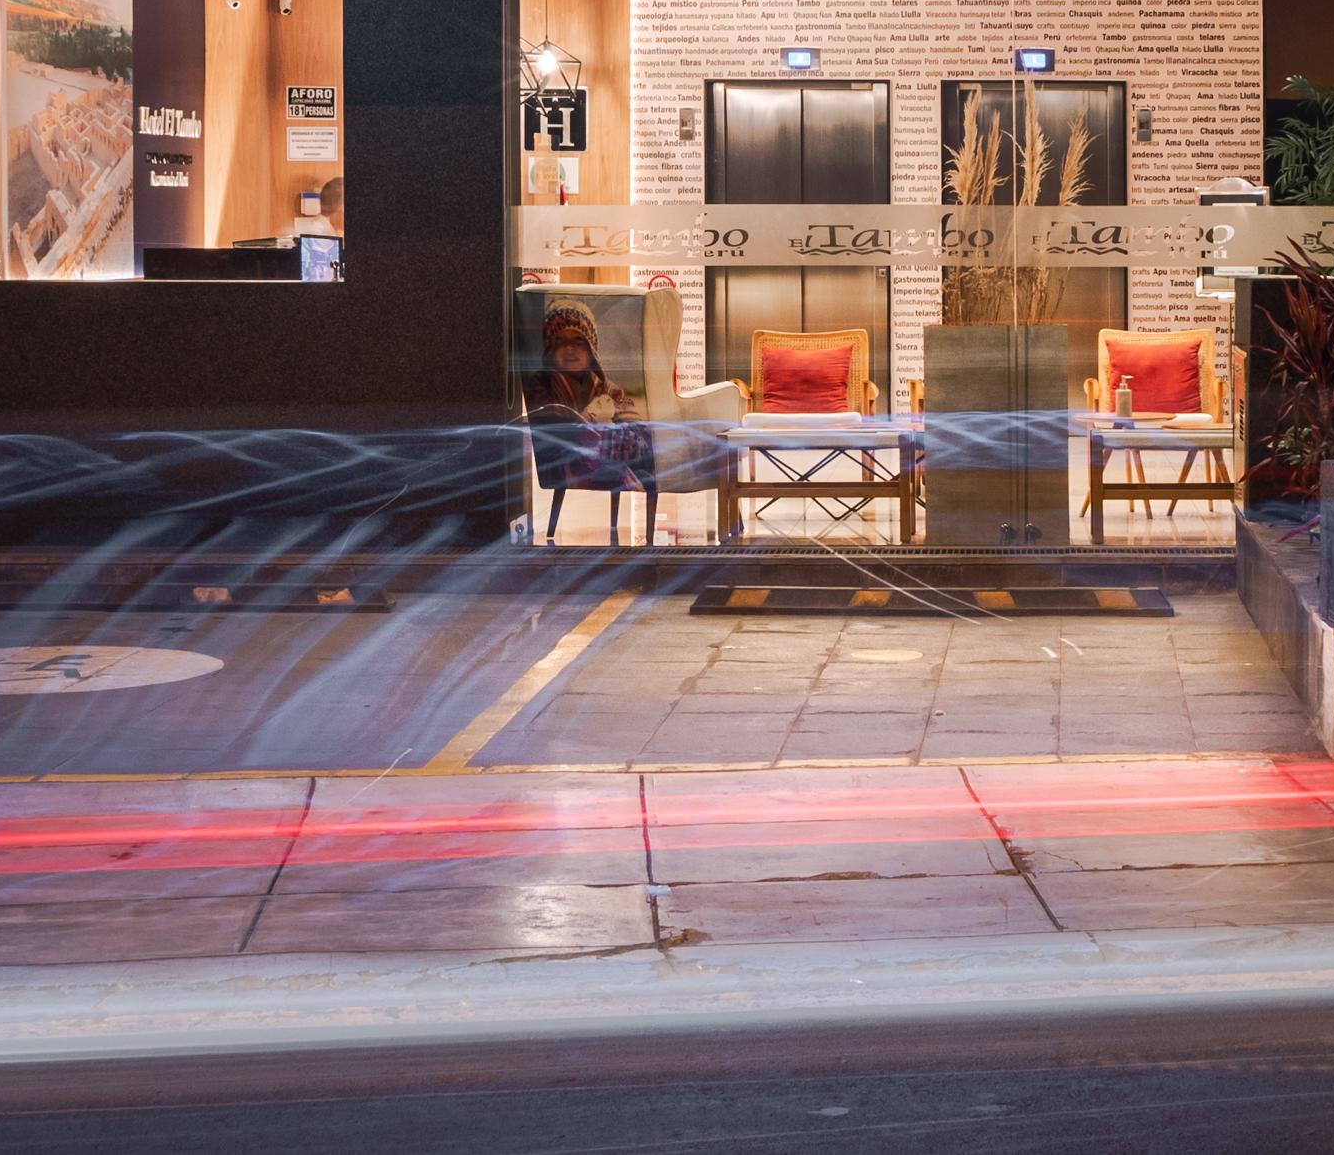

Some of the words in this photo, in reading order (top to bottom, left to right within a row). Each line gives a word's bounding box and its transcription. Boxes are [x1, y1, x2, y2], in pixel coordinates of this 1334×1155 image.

[652, 0, 667, 10] Apu
[742, 0, 759, 7] Perú
[761, 11, 775, 21] Apu
[901, 10, 921, 18] Llulla
[1069, 10, 1103, 19] Chasquis
[652, 23, 677, 32] tejidos
[1141, 22, 1166, 31] quinoa
[1192, 22, 1215, 31] piedra
[794, 34, 809, 44] Apu
[909, 33, 929, 41] Llulla
[935, 33, 950, 41] arte
[1103, 33, 1126, 41] Tambo
[1199, 33, 1225, 41] telares
[875, 46, 895, 55] pisco
[968, 45, 985, 53] Tumi
[1063, 45, 1077, 54] Apu
[1156, 45, 1179, 54] quella
[1203, 44, 1223, 53] Llulla
[680, 58, 701, 66] fibras
[856, 57, 872, 65] Ama
[874, 57, 888, 65] Sua
[751, 70, 776, 78] telares
[1096, 68, 1111, 76] lana
[1182, 68, 1218, 76] Viracocha
[917, 82, 937, 90] Llulla
[1234, 80, 1260, 88] telares
[291, 88, 333, 99] AFORO
[1131, 92, 1145, 101] Apu
[1240, 91, 1260, 99] Llulla
[289, 105, 305, 116] 181
[305, 106, 334, 117] PERSONAS
[651, 105, 676, 113] telares
[1219, 103, 1240, 111] fibras
[1192, 115, 1216, 125] piedra
[1241, 115, 1260, 125] pisco
[1200, 127, 1234, 137] Chasquis
[664, 139, 686, 147] Andes
[1185, 138, 1209, 148] Quella
[895, 149, 920, 159] quinoa
[1218, 151, 1260, 160] chinchaysuyo
[661, 162, 683, 170] fibras
[918, 162, 938, 172] pisco
[1196, 162, 1218, 170] Sierra
[1221, 163, 1239, 172] quipu
[1244, 163, 1260, 172] pisco
[658, 174, 683, 184] quinoa
[892, 173, 915, 182] piedra
[678, 186, 701, 196] piedra
[807, 212, 995, 248] Tambo
[1153, 268, 1167, 277] Apu
[680, 280, 703, 289] piedra
[1171, 279, 1194, 287] Tambo
[894, 287, 922, 297] Imperio
[923, 287, 939, 295] inca
[1169, 303, 1188, 312] pisco
[1174, 314, 1190, 322] Ama
[1193, 315, 1216, 324] quella
